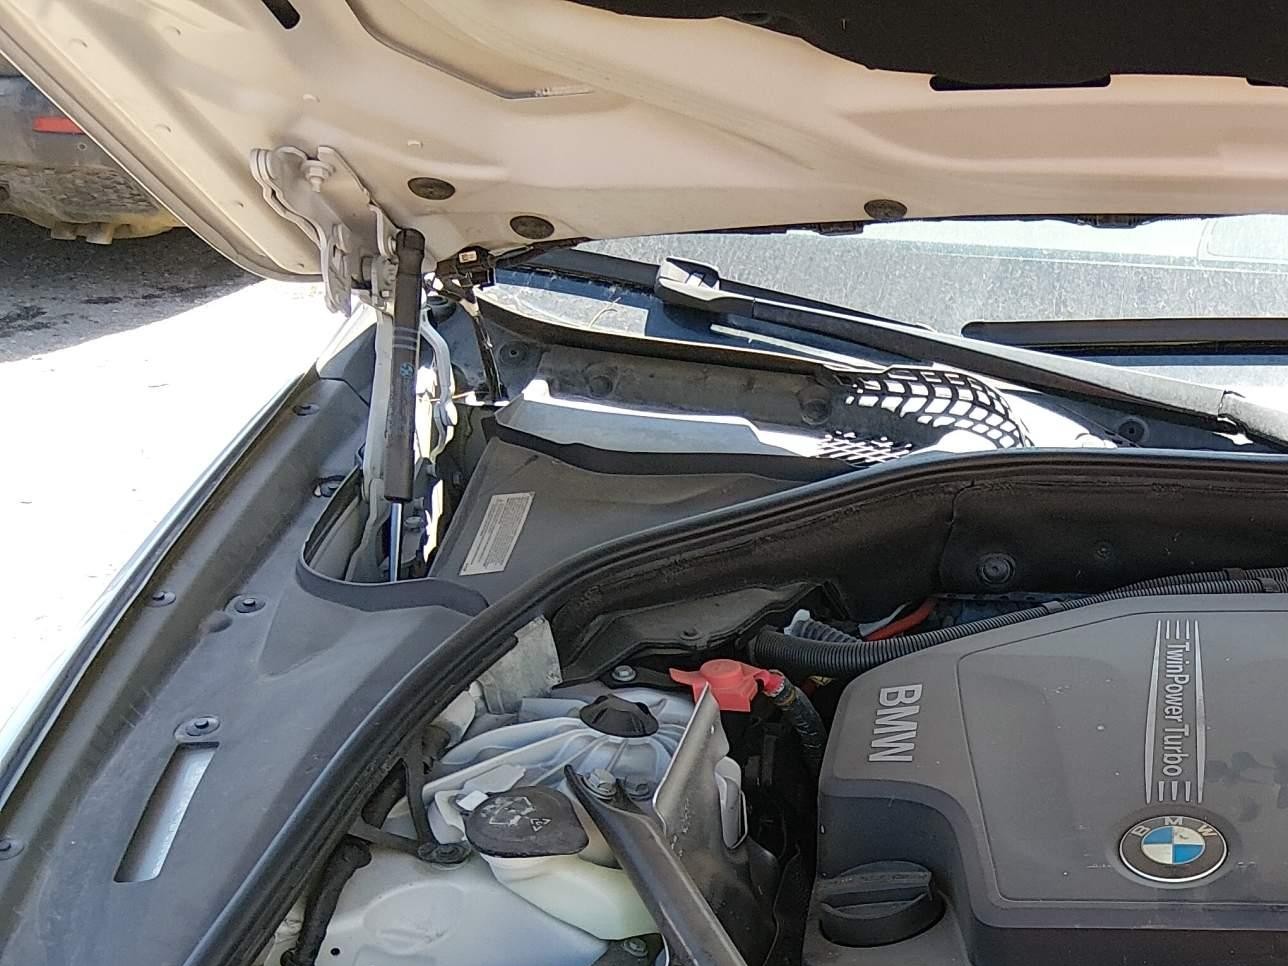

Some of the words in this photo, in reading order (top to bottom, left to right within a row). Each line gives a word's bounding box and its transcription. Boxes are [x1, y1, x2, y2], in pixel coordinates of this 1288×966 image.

[1164, 641, 1191, 722] TwinPower
[868, 683, 923, 762] BMW
[1162, 723, 1190, 777] Turbo
[1130, 815, 1218, 838] BMW
